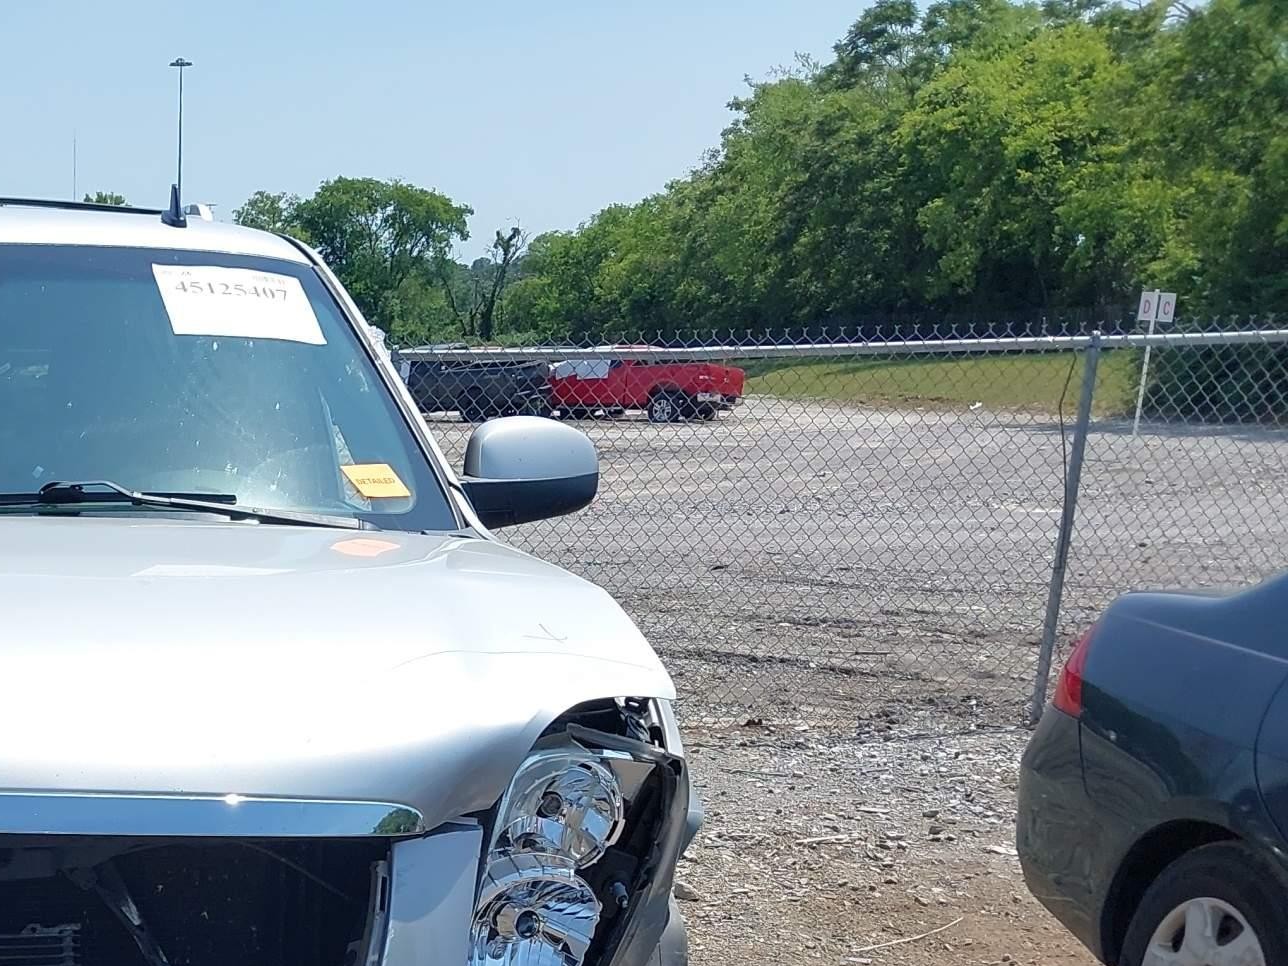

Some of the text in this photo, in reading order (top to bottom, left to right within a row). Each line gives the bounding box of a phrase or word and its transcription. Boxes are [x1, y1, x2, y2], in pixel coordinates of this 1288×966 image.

[175, 280, 288, 302] 45125407
[1143, 299, 1151, 314] D
[1163, 301, 1171, 316] C
[354, 477, 396, 486] DETAILED
